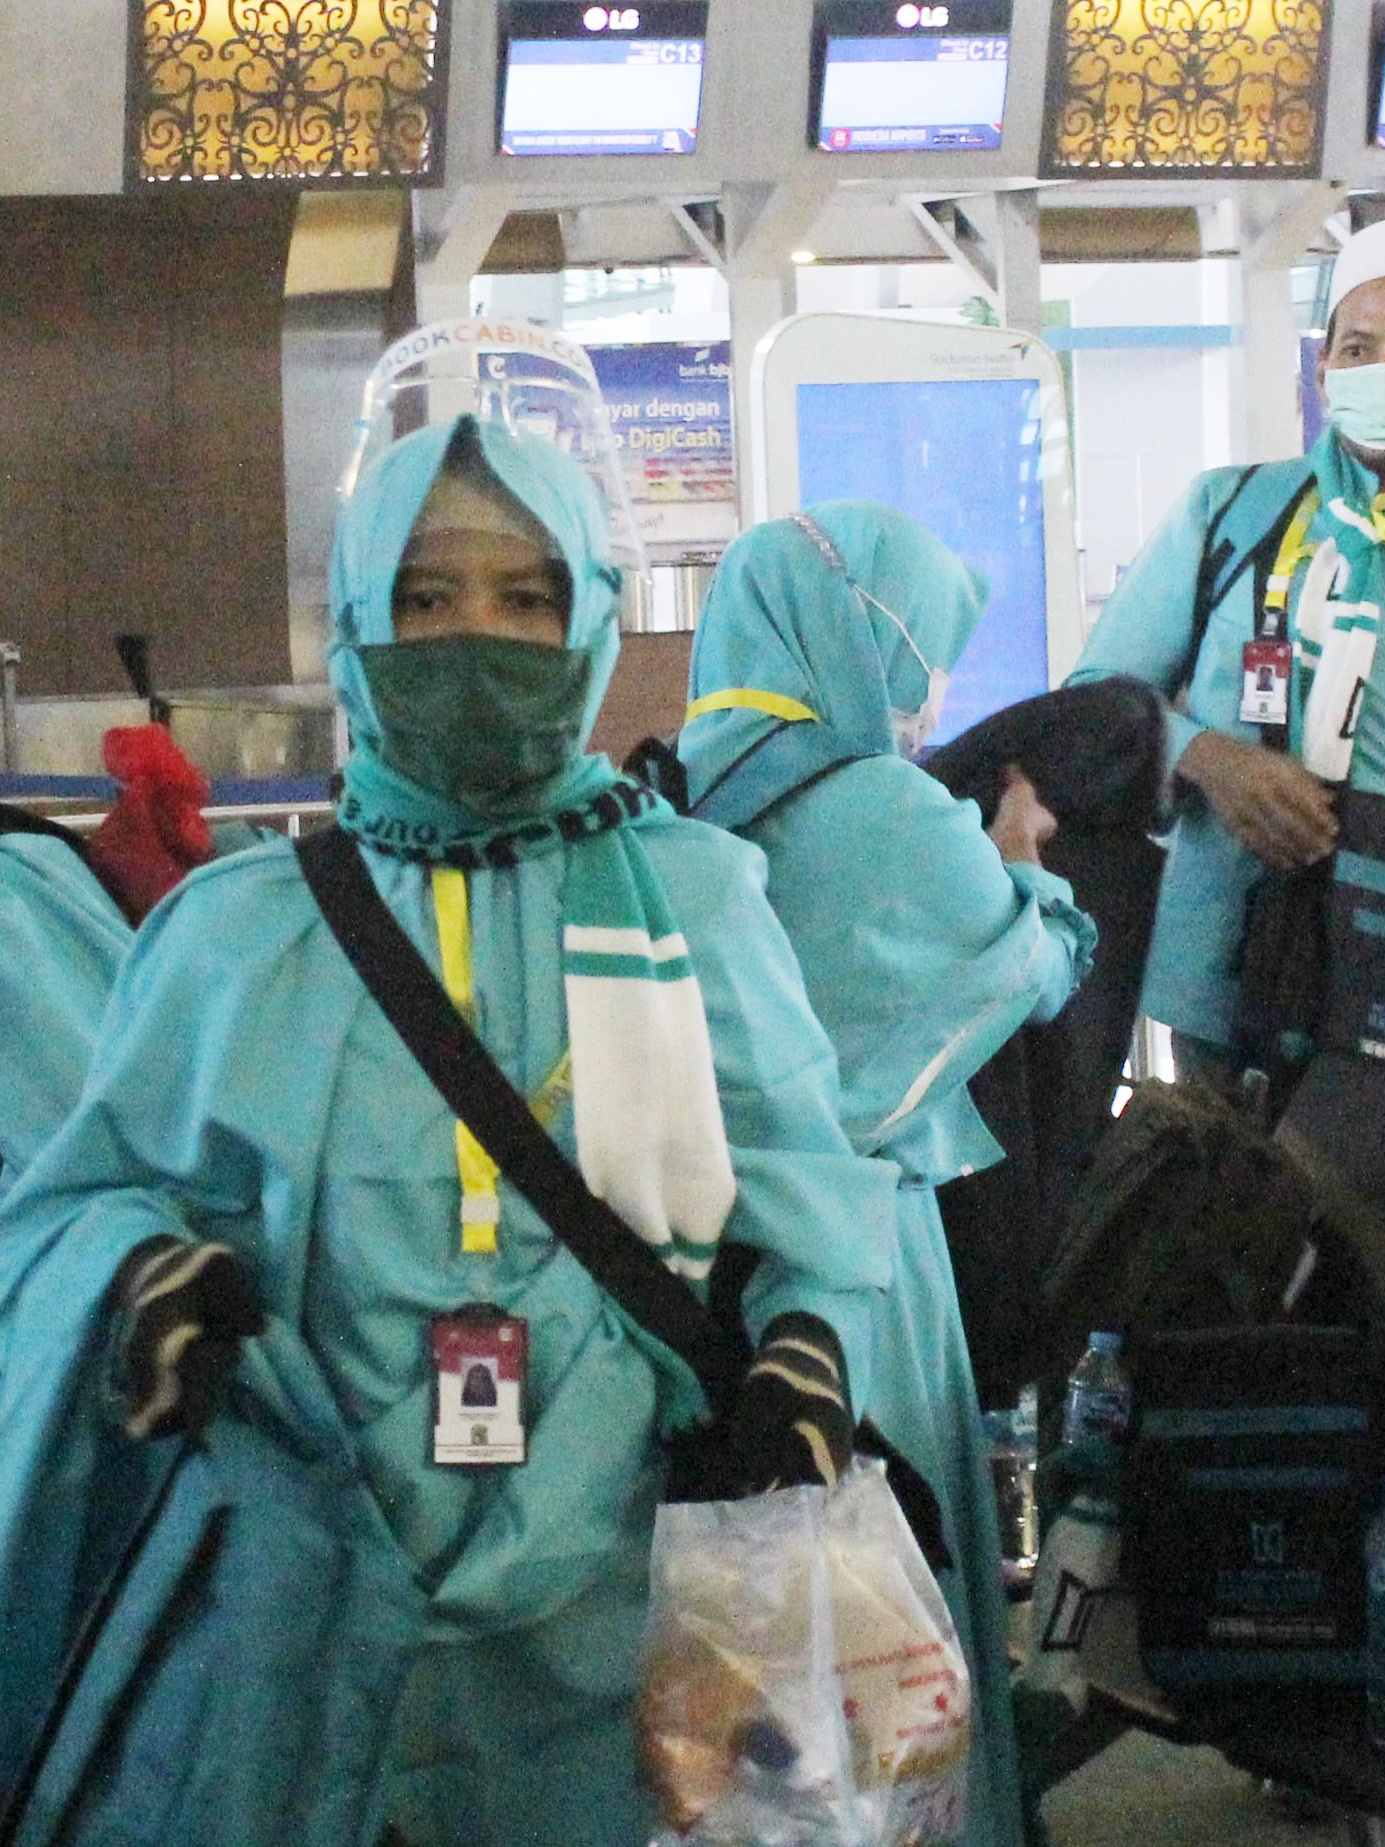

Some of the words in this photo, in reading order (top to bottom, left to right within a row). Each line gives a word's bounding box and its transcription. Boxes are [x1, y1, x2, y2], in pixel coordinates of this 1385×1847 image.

[609, 9, 640, 30] LG
[921, 6, 950, 27] LG
[660, 43, 702, 64] C13
[968, 40, 1009, 60] C12
[646, 397, 720, 422] dengan
[629, 424, 722, 453] DigiCash
